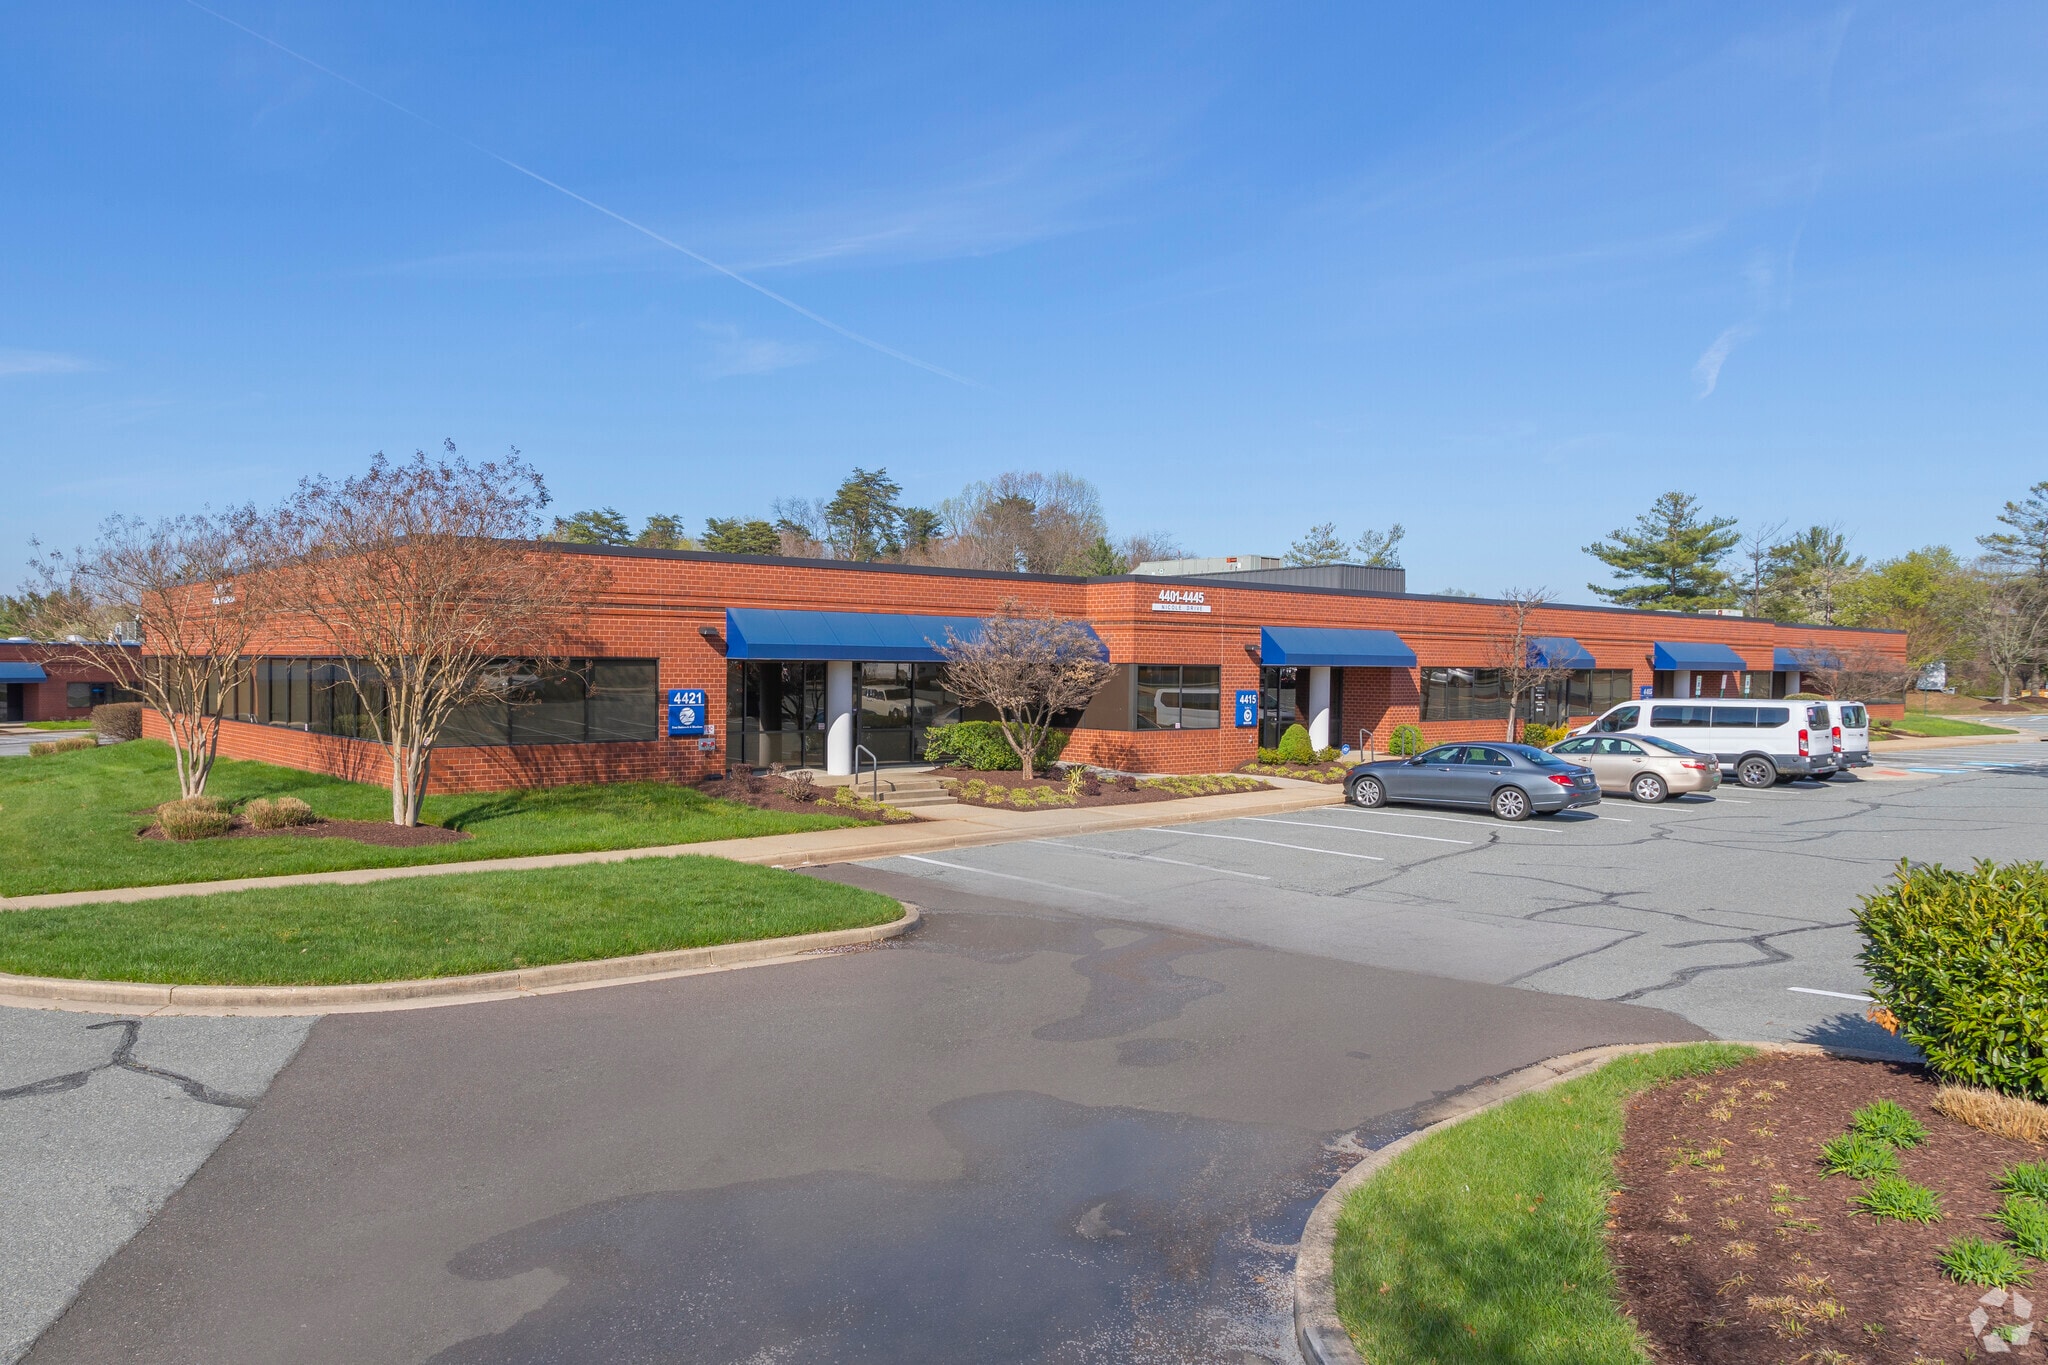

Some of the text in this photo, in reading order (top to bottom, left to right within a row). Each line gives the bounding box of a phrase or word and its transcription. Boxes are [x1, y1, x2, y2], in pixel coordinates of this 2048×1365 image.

[1158, 589, 1204, 603] 4401-4445
[673, 692, 702, 704] 4421
[1239, 694, 1257, 704] 4415
